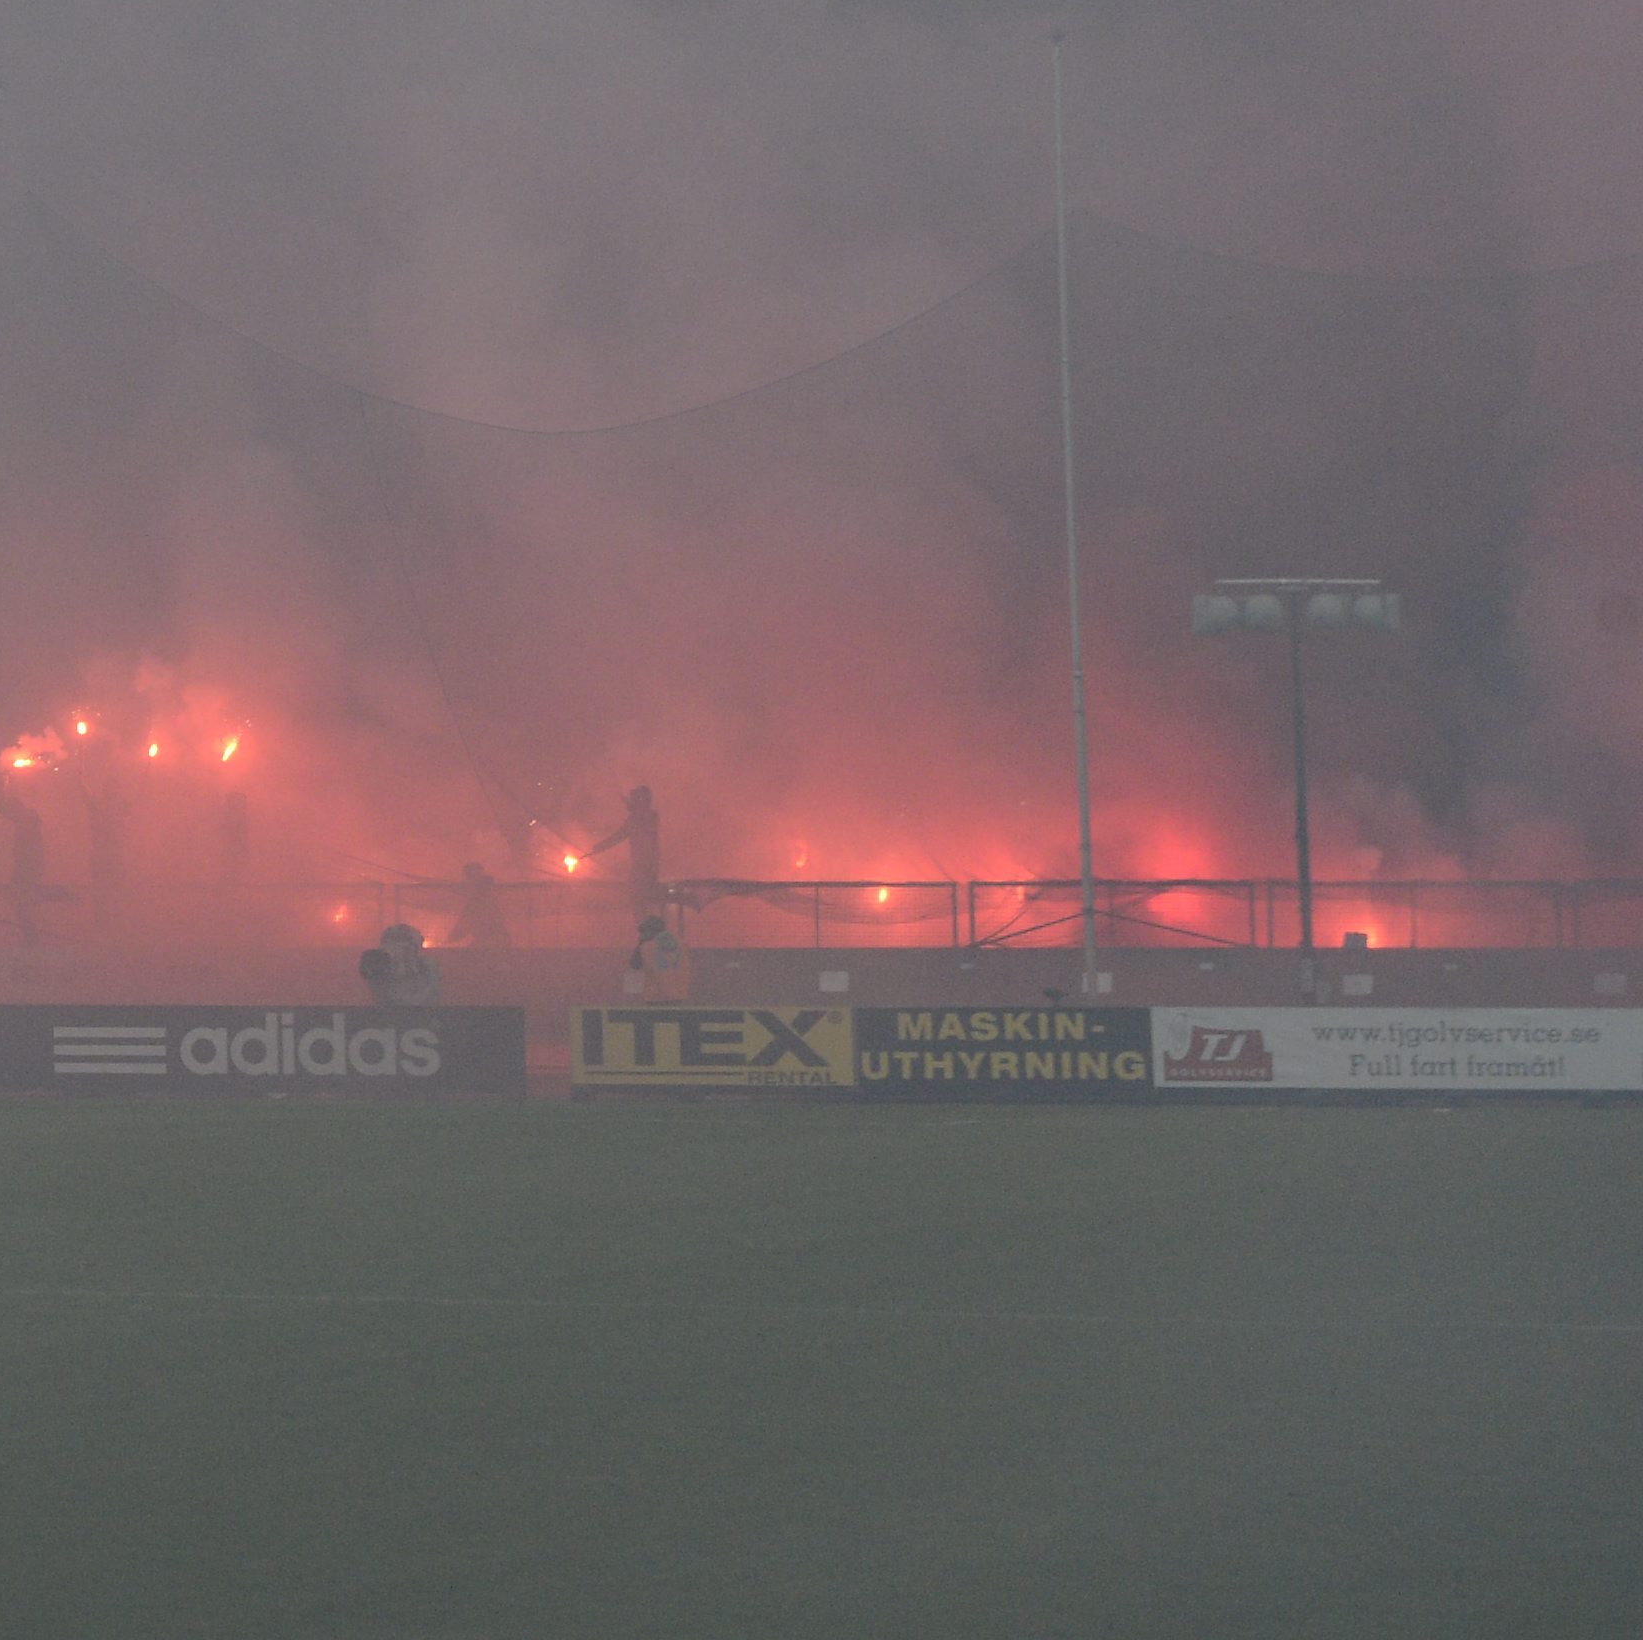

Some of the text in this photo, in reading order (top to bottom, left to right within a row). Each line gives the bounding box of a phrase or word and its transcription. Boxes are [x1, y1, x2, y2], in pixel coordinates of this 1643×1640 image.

[582, 1009, 830, 1067] ITEX
[896, 1011, 1106, 1042] MASKIN-
[1312, 1021, 1601, 1047] www.tjgolvservice.se
[179, 1012, 442, 1077] adidas
[747, 1069, 838, 1087] RENTAL
[861, 1050, 1146, 1082] UTHYRNING
[1348, 1053, 1402, 1077] Full
[1410, 1053, 1457, 1077] fart
